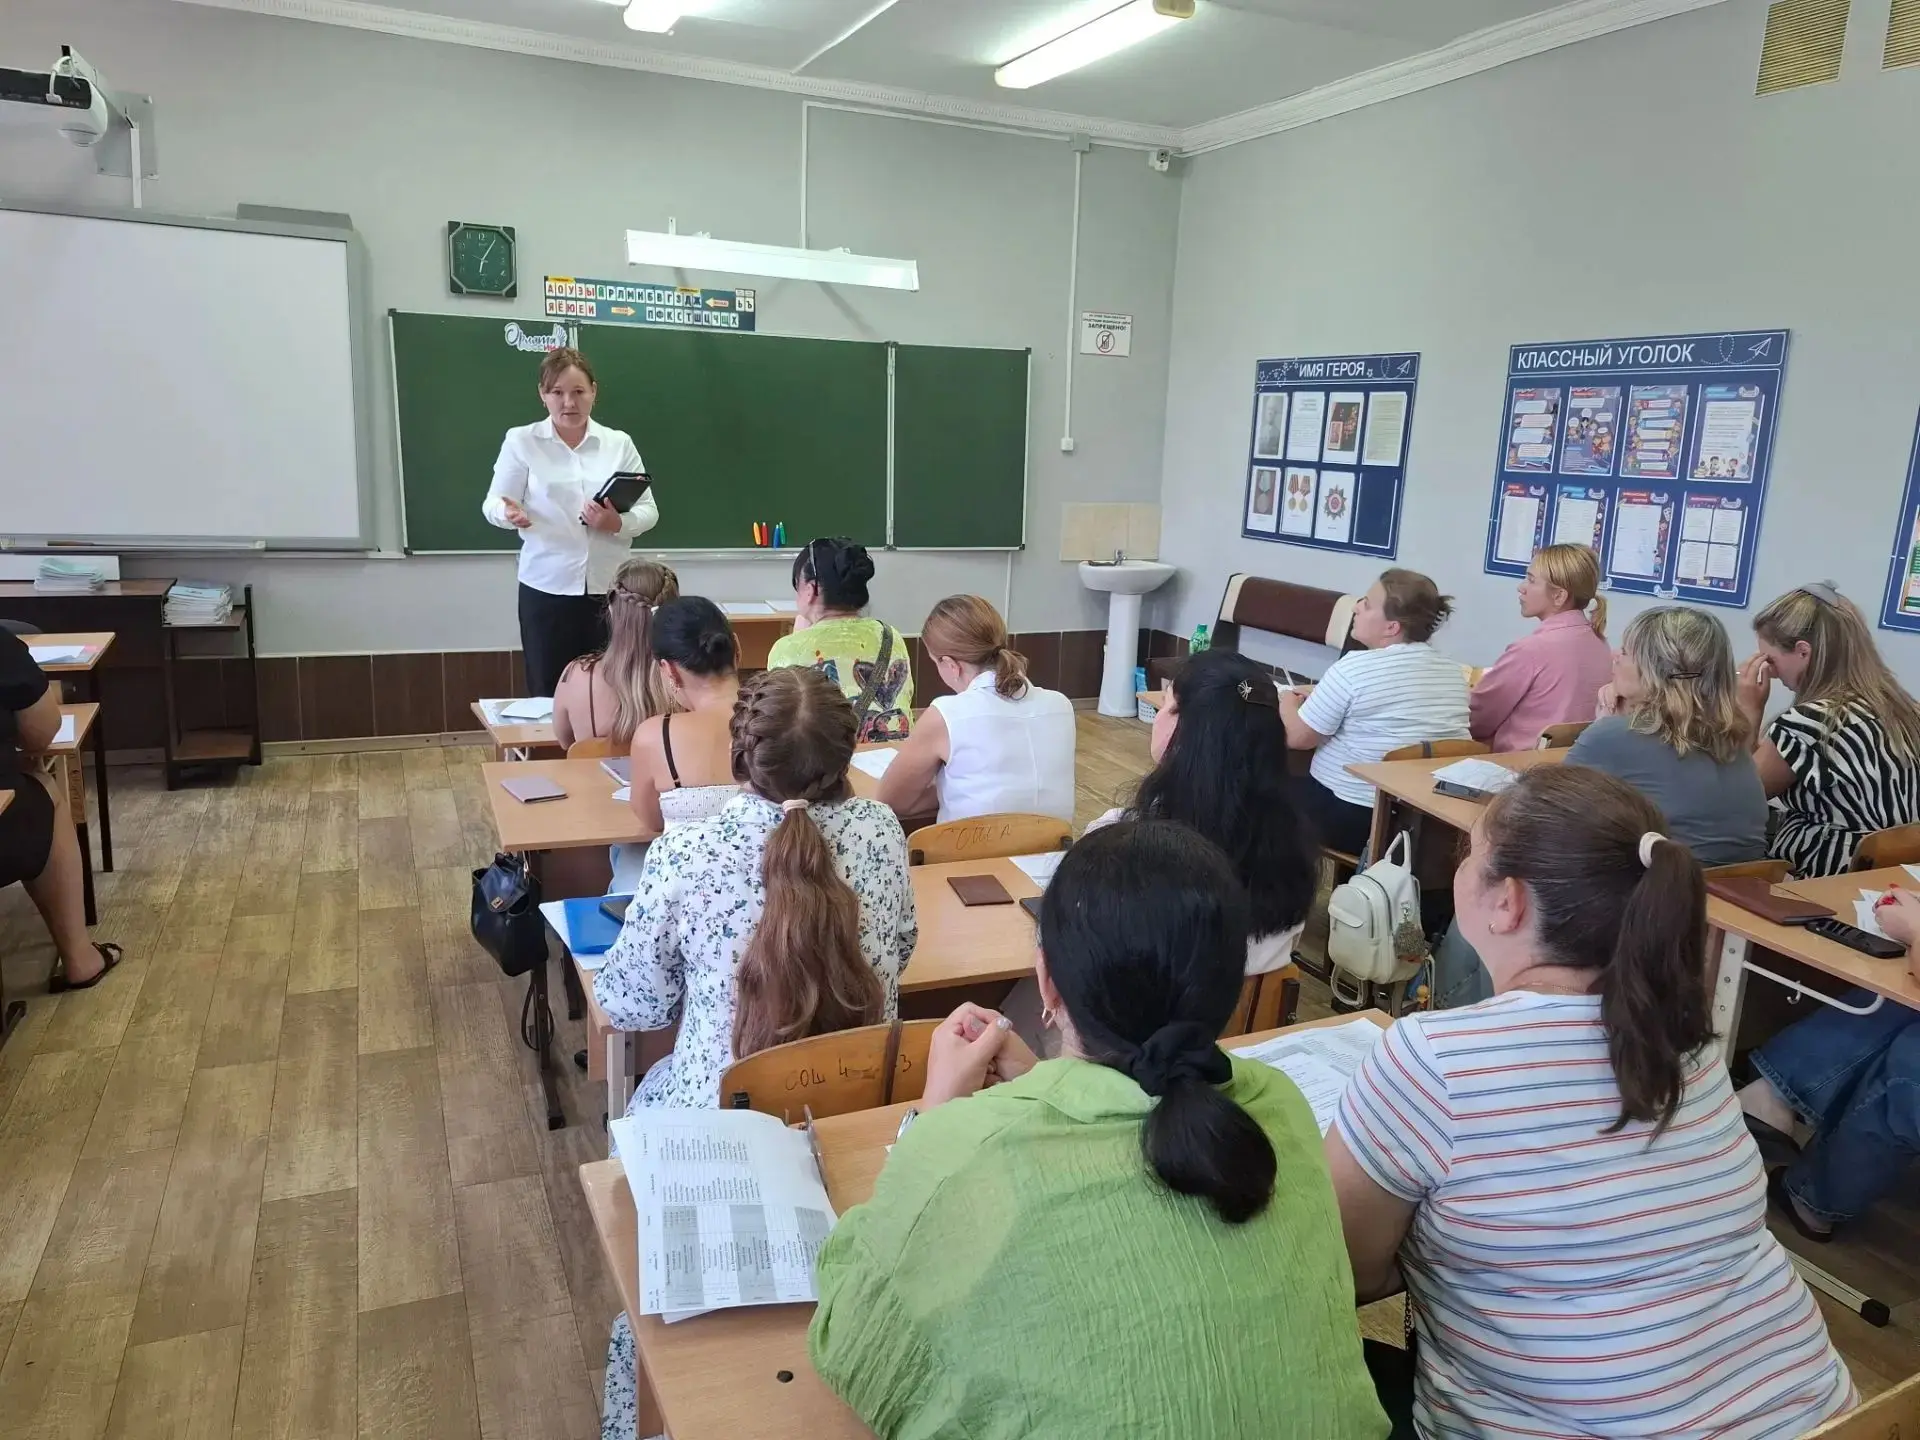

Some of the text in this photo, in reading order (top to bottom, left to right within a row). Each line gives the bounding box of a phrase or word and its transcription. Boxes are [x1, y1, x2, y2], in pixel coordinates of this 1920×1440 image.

[1517, 343, 1696, 369] КЛАССНЫЙ УГОЛОК
[1299, 361, 1365, 378] ИМЯ ГЕРОЯ
